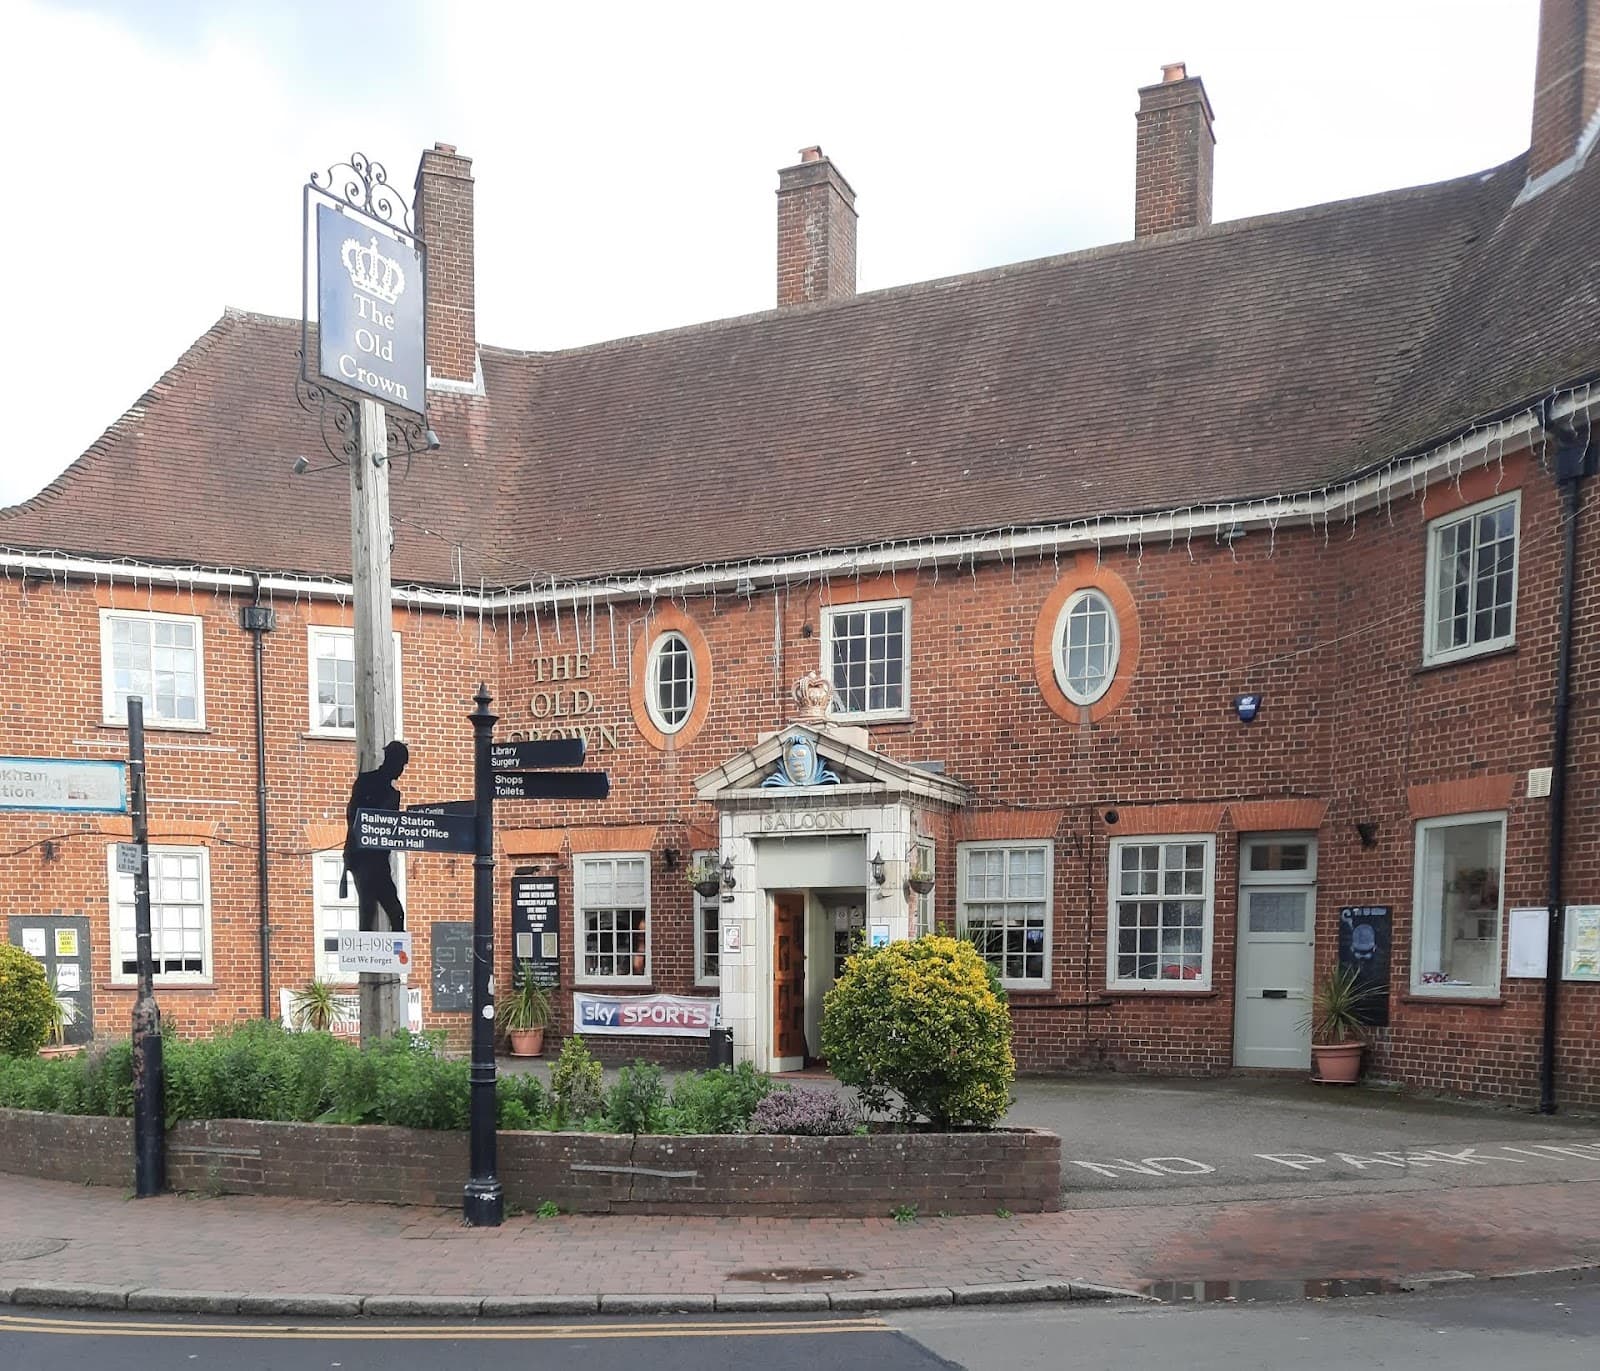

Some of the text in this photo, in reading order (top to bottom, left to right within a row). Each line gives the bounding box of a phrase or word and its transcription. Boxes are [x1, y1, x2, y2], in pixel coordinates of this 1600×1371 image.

[353, 293, 395, 331] The
[355, 328, 393, 362] Old
[339, 354, 408, 401] Crown
[531, 653, 591, 682] THE
[530, 689, 594, 718] OLD
[491, 746, 517, 756] Library
[491, 757, 520, 768] Surgery
[495, 774, 523, 785] Shops
[495, 786, 525, 796] Toilets
[361, 813, 435, 827] Railway Station
[764, 811, 845, 831] SALOON
[421, 828, 449, 839] Office
[361, 836, 424, 849] Old Barn Hall
[342, 955, 392, 966] Lest We Forget
[584, 1002, 617, 1026] sky
[623, 1005, 707, 1025] SPORTS
[1069, 1143, 1600, 1178] NO PARKIN
